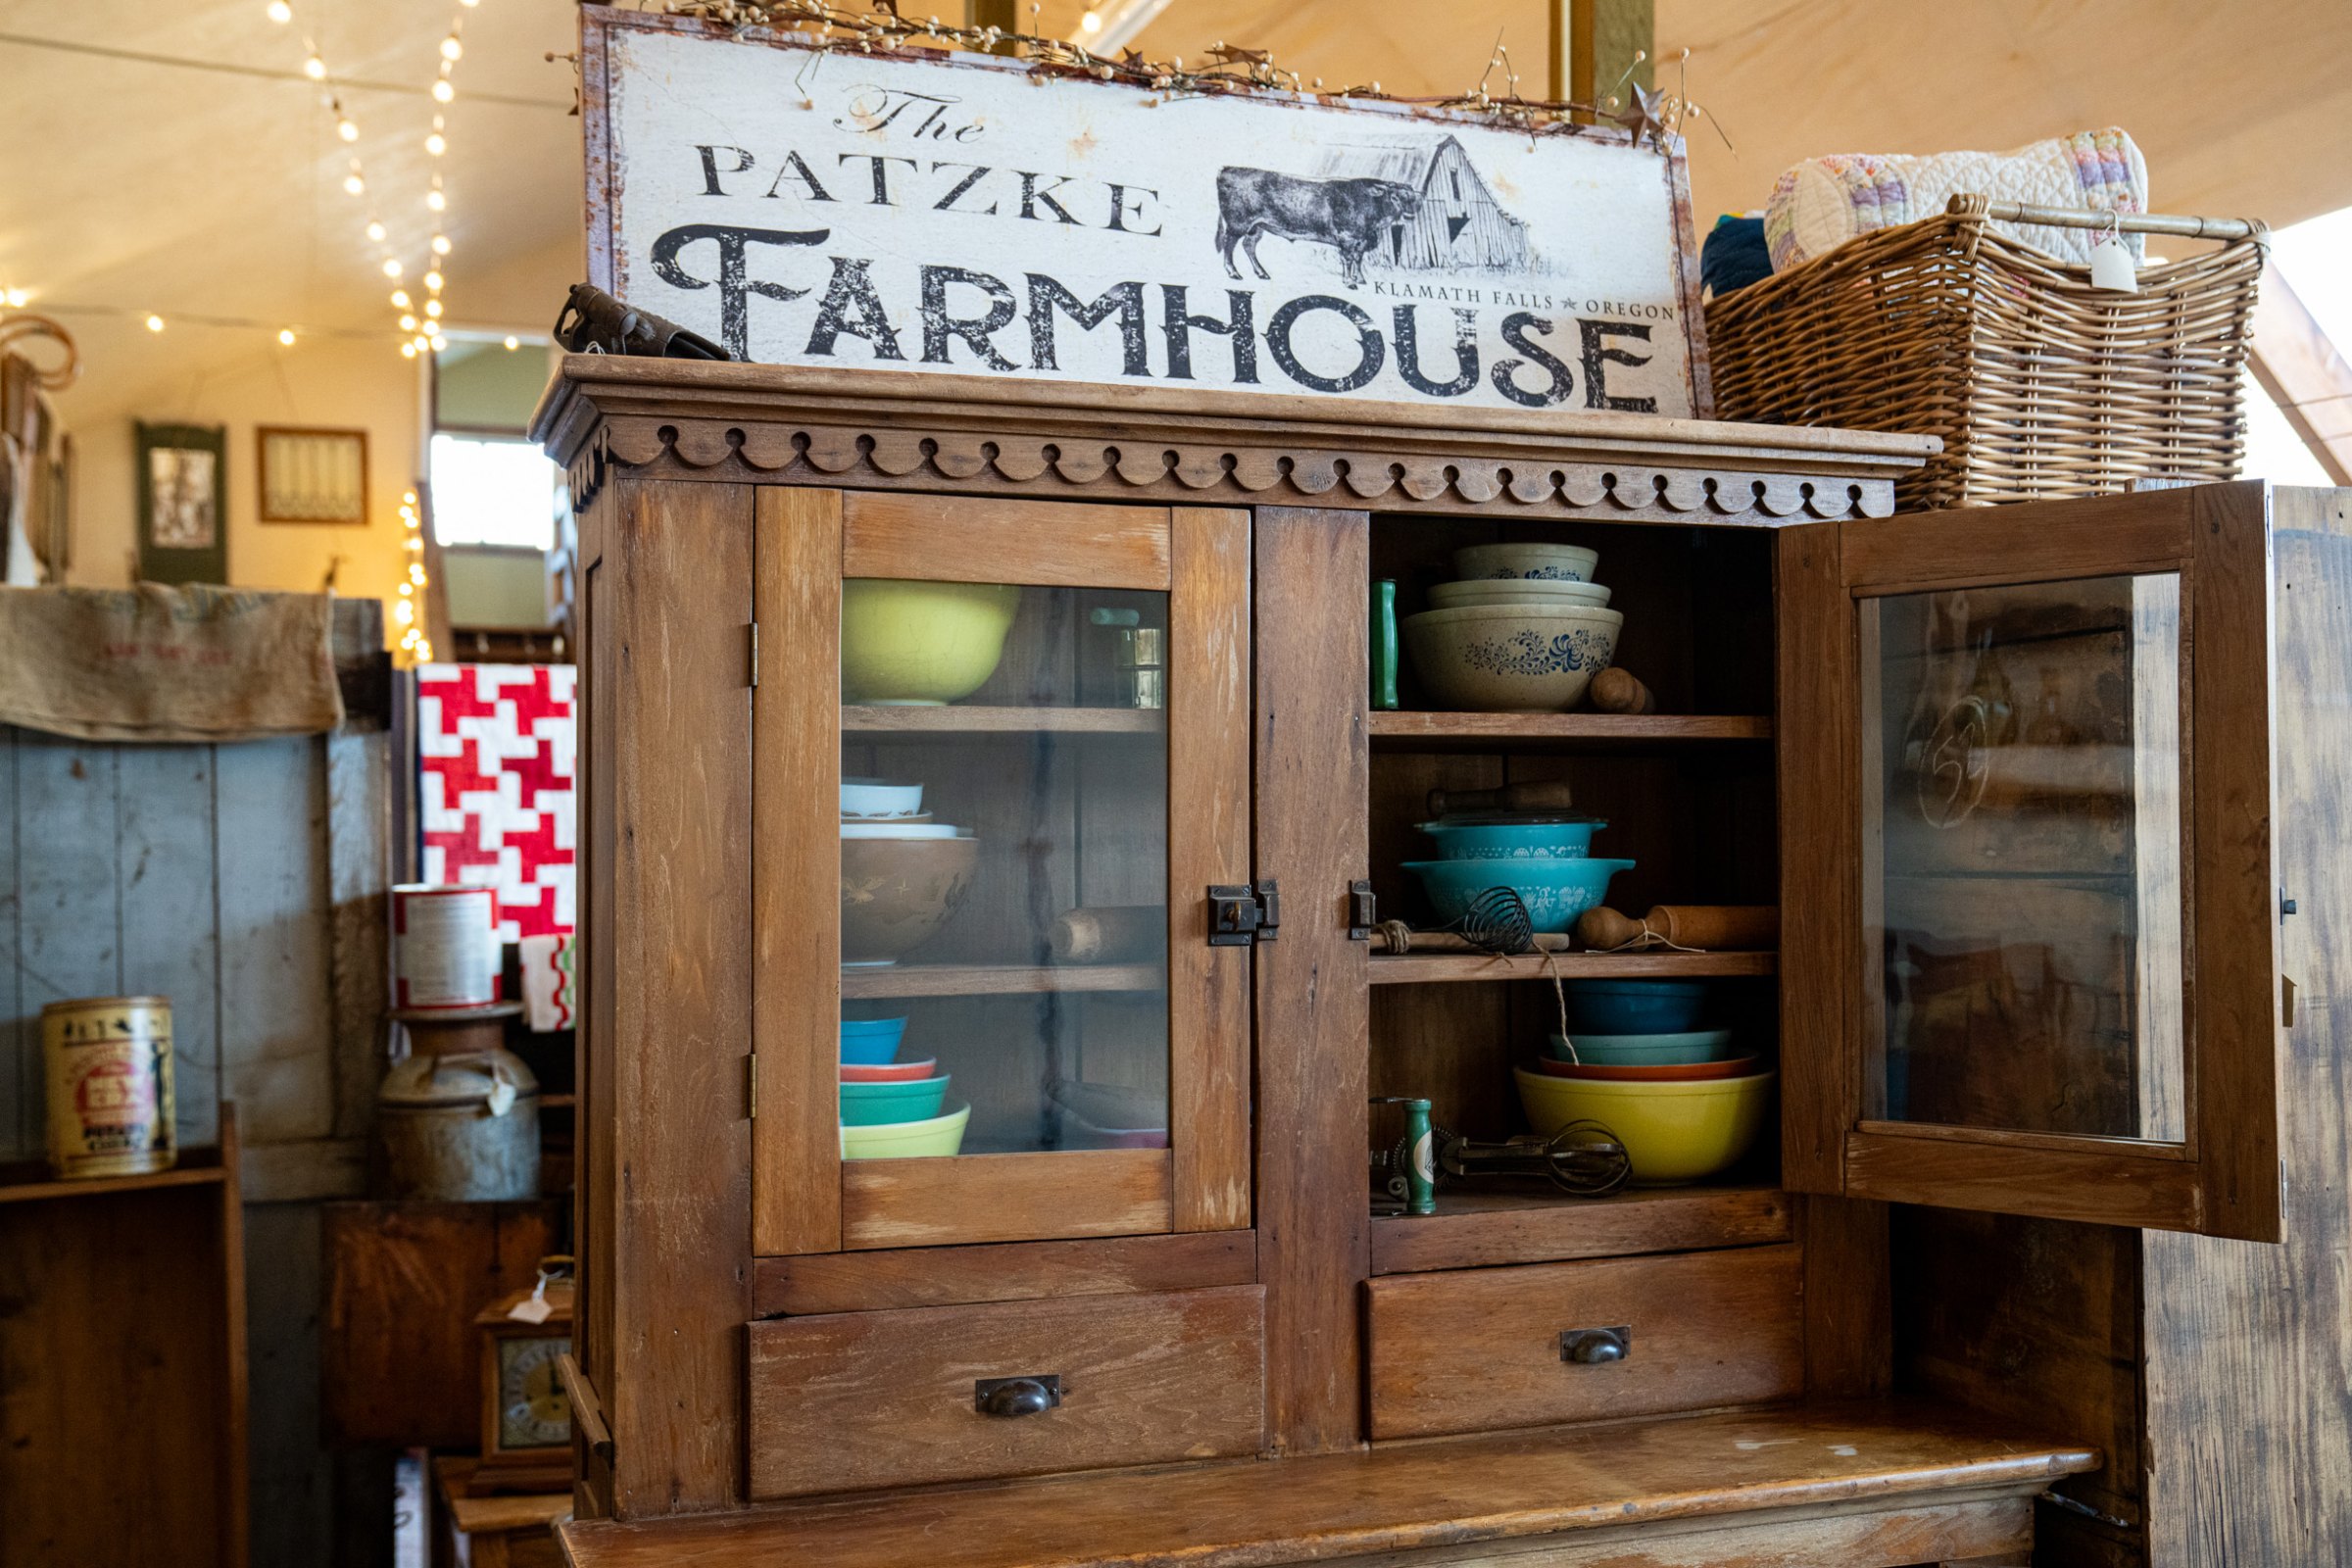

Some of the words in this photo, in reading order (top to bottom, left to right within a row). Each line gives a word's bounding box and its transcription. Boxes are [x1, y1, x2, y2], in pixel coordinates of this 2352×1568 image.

[833, 84, 985, 143] The
[695, 145, 1162, 236] PATZKE
[651, 223, 1659, 415] FARMHOUSE
[1374, 280, 1481, 303] KLAMATH
[1493, 291, 1552, 310] FALLS
[1586, 299, 1674, 320] OREGON
